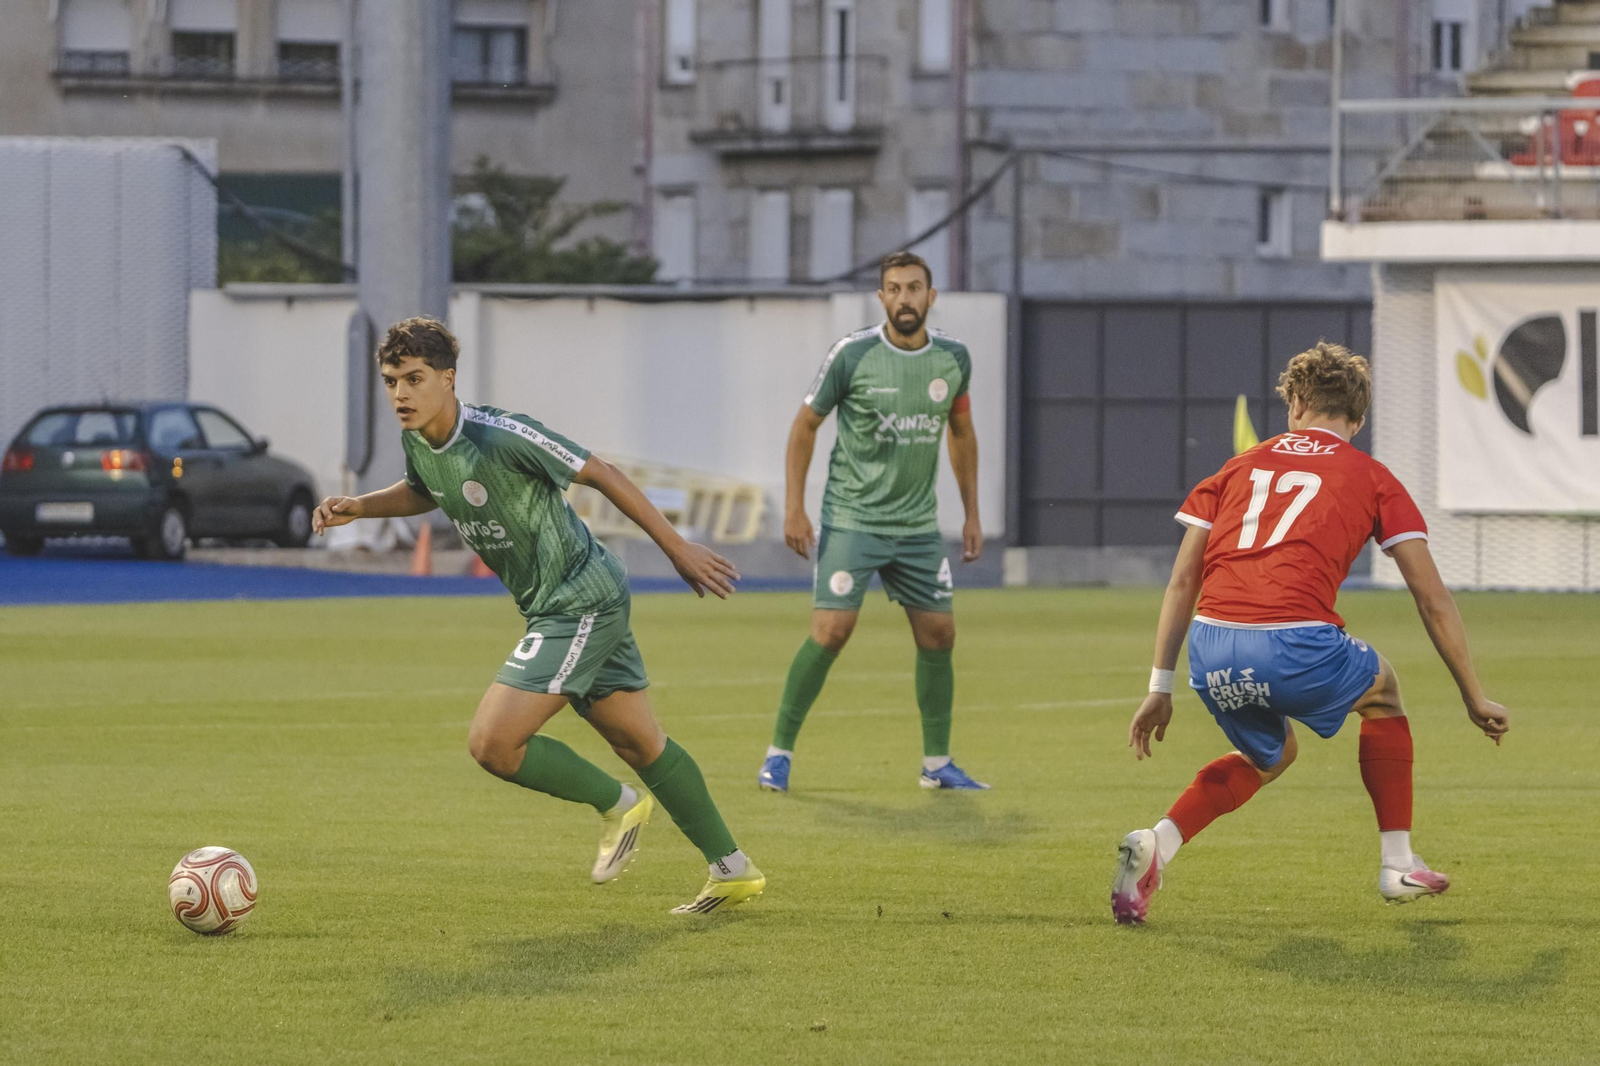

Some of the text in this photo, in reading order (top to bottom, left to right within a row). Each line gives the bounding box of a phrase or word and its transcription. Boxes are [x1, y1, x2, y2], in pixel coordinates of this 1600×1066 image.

[521, 426, 538, 440] QUE
[873, 408, 941, 437] XUNTOS
[1237, 467, 1323, 550] 17
[936, 556, 954, 590] 4
[1206, 667, 1233, 688] MY
[1209, 682, 1271, 701] CRUSH
[1216, 695, 1271, 713] PIZZA
